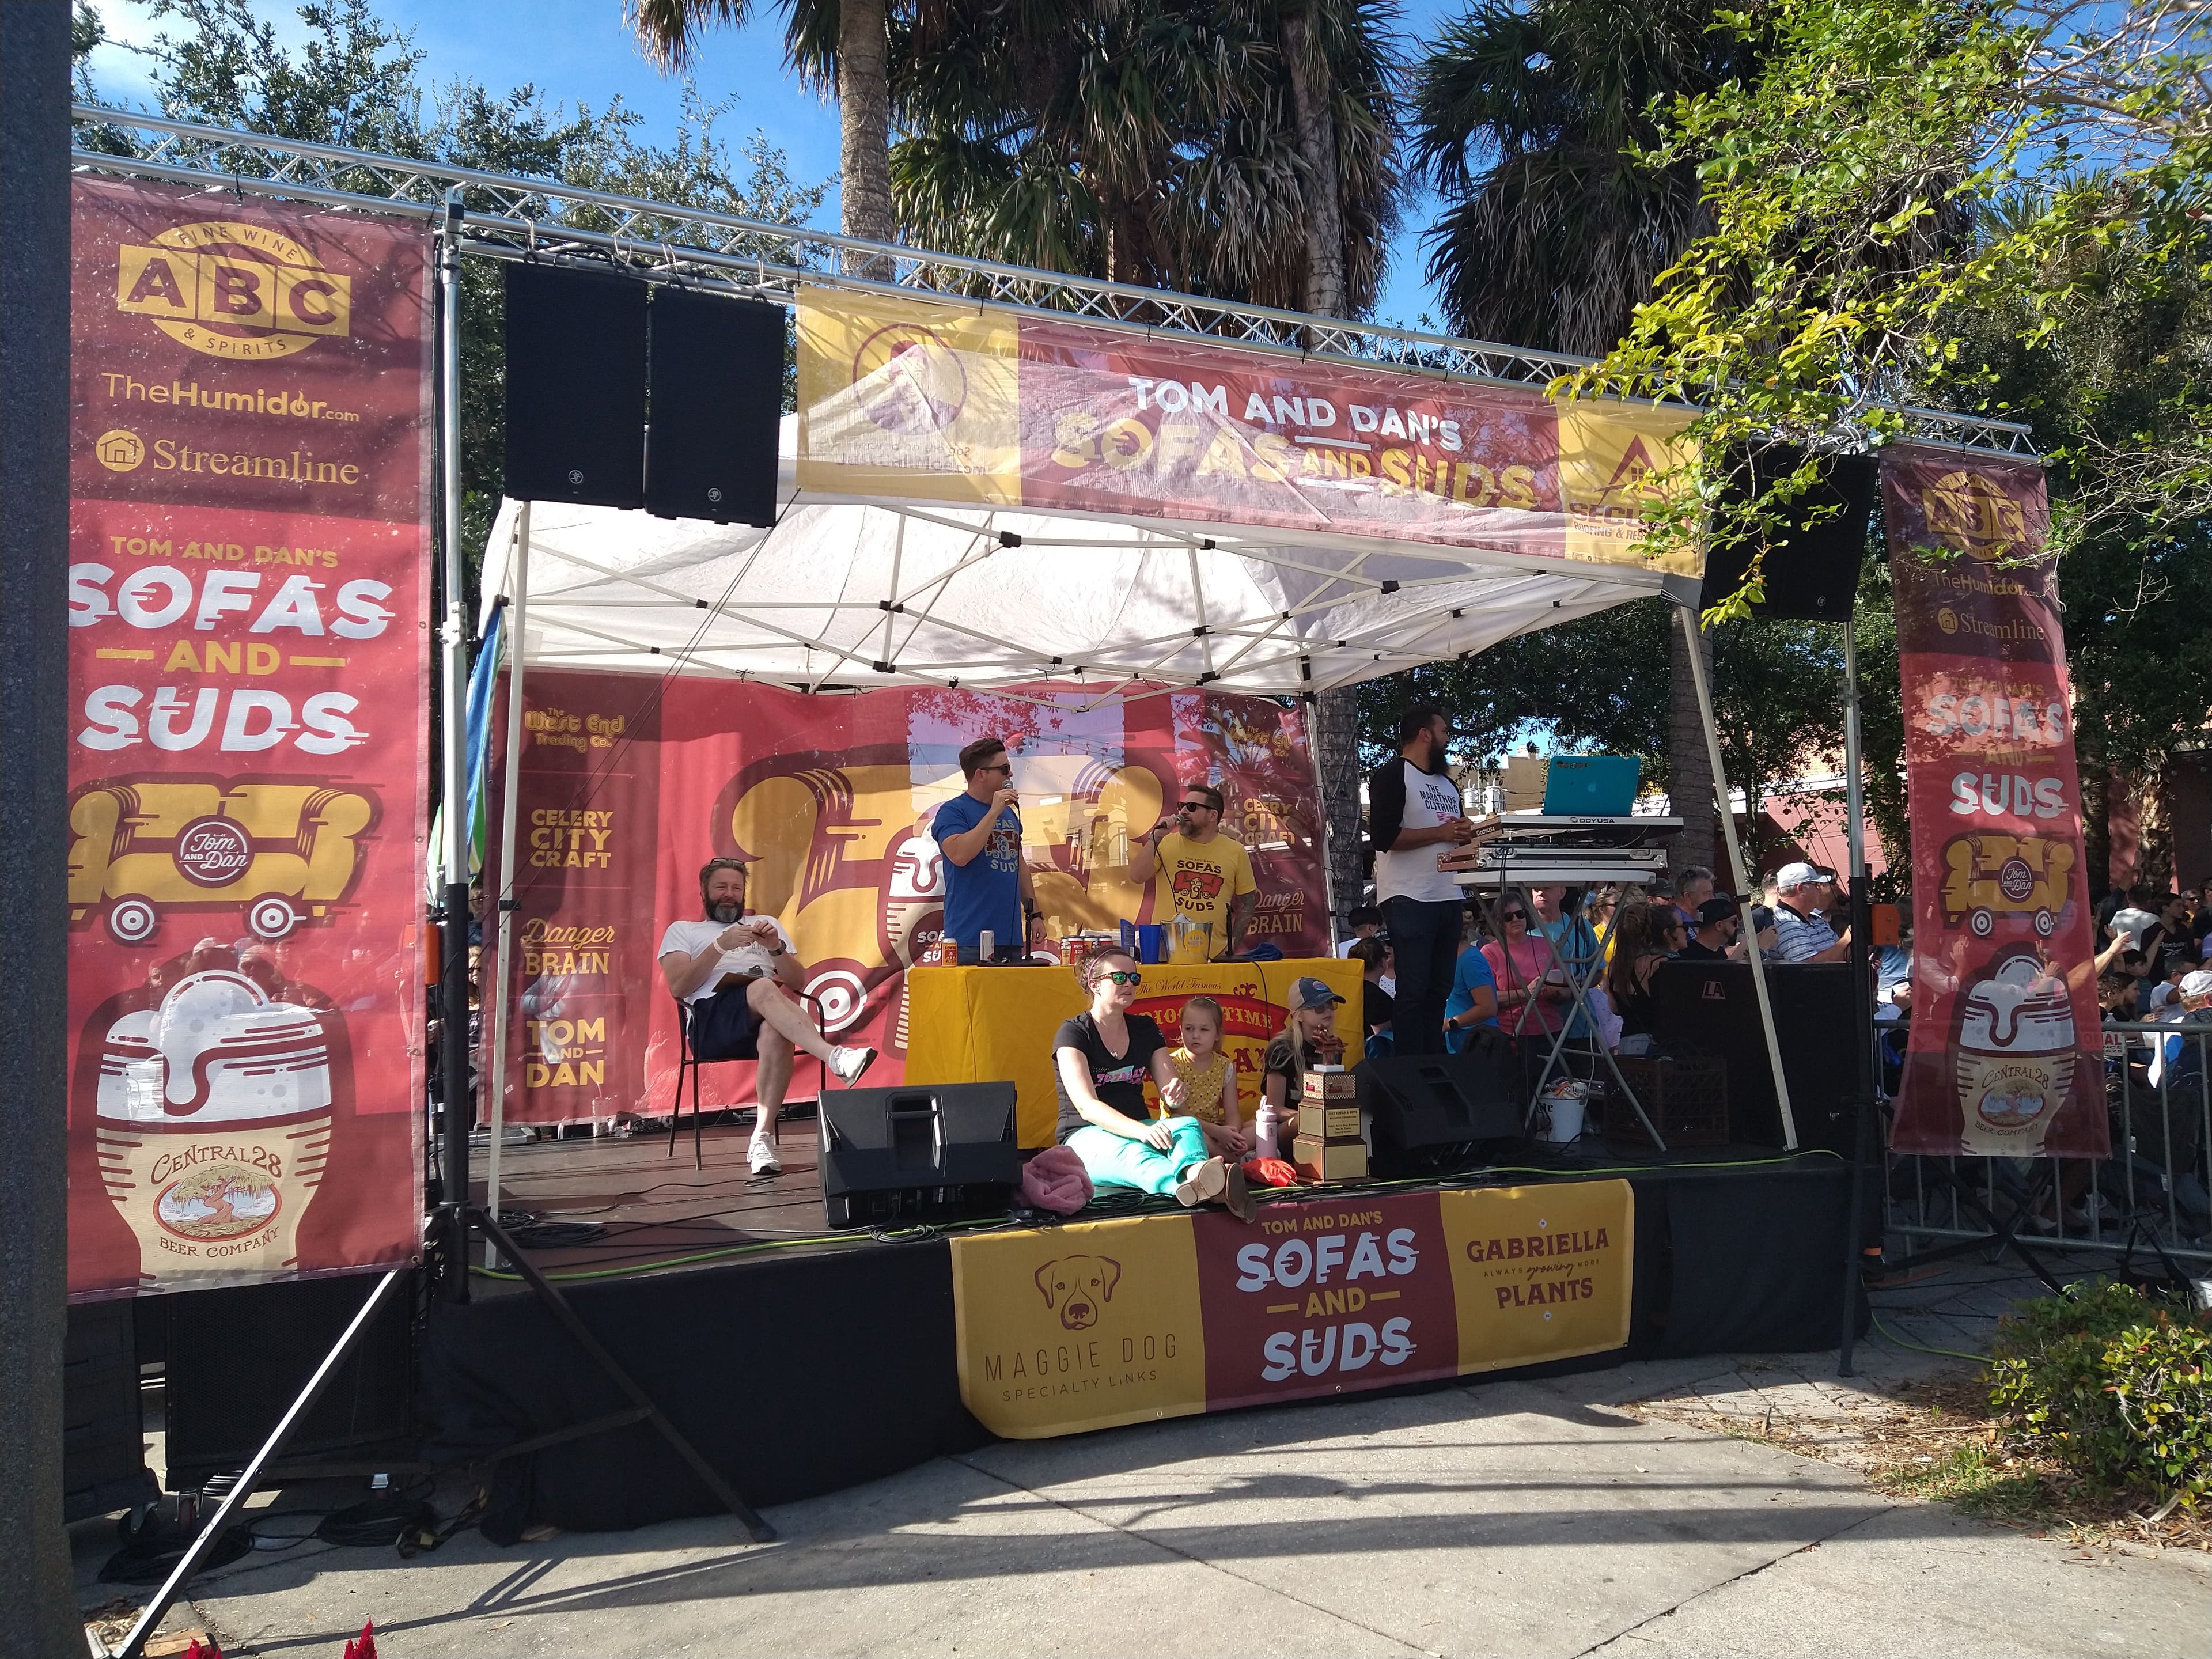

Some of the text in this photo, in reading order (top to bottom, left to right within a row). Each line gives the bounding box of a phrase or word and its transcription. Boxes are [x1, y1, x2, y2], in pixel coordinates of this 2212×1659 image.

[179, 226, 298, 261] FINE WINE
[126, 257, 338, 326] ABC
[184, 328, 287, 355] & SPIRITS
[1127, 376, 1463, 452] TOM AND DAN'S
[153, 439, 361, 485] Streamline
[1050, 411, 1544, 511] SOFAS AND SUDS
[1930, 496, 2020, 535] ABC
[1573, 521, 1612, 537] ROOFING
[1615, 527, 1624, 539] &
[109, 536, 339, 569] TOM AND DAN'S
[1968, 547, 1999, 557] SPIRIT
[69, 562, 396, 640] SOFAS
[1960, 613, 2046, 641] Streamline
[163, 639, 281, 676] AND
[76, 684, 370, 755] SUDS
[547, 707, 565, 717] The
[1926, 693, 2065, 743] SOFAS
[524, 710, 626, 738] West End
[1247, 725, 1259, 733] The
[533, 733, 613, 753] Trading Co.
[1983, 745, 2025, 767] AND
[1419, 790, 1458, 805] MARATHON
[1425, 783, 1441, 794] THE
[1949, 772, 2069, 819] SUDS
[531, 809, 614, 828] CELERY
[994, 819, 1015, 829] FAS
[1244, 813, 1291, 831] CITY
[190, 832, 237, 853] Tom
[530, 828, 612, 850] CITY
[1244, 831, 1296, 846] CRAFT
[199, 850, 249, 869] Dan
[529, 850, 612, 868] CRAFT
[1176, 859, 1222, 874] SOFAS
[2006, 868, 2027, 880] Tom
[2010, 879, 2033, 891] Dan
[1175, 896, 1215, 912] SUDS
[520, 918, 616, 951] Danger
[1247, 914, 1303, 935] BRAIN
[916, 930, 945, 943] SOF
[524, 952, 610, 975] BRAIN
[922, 949, 942, 963] SU
[1135, 976, 1222, 995] The World Famous
[1221, 1006, 1273, 1030] TIME
[525, 1017, 605, 1047] TOM
[550, 1047, 584, 1059] AND
[525, 1060, 604, 1088] DAN
[1975, 1120, 2040, 1137] BEER COMPANY
[1260, 1210, 1383, 1236] TOM AND DAN'S
[158, 1226, 279, 1258] BEER COMPANY
[1466, 1228, 1609, 1263] GABRIELLA
[1236, 1228, 1420, 1293] SOFAS
[1484, 1258, 1600, 1281] ALWAYS growing MORE
[1304, 1287, 1366, 1319] AND
[1494, 1277, 1594, 1309] PLANTS
[985, 1333, 1177, 1382] MAGGIE DOG
[1260, 1317, 1418, 1381] SUDS
[1002, 1370, 1158, 1402] SPECIALTY LINKS
